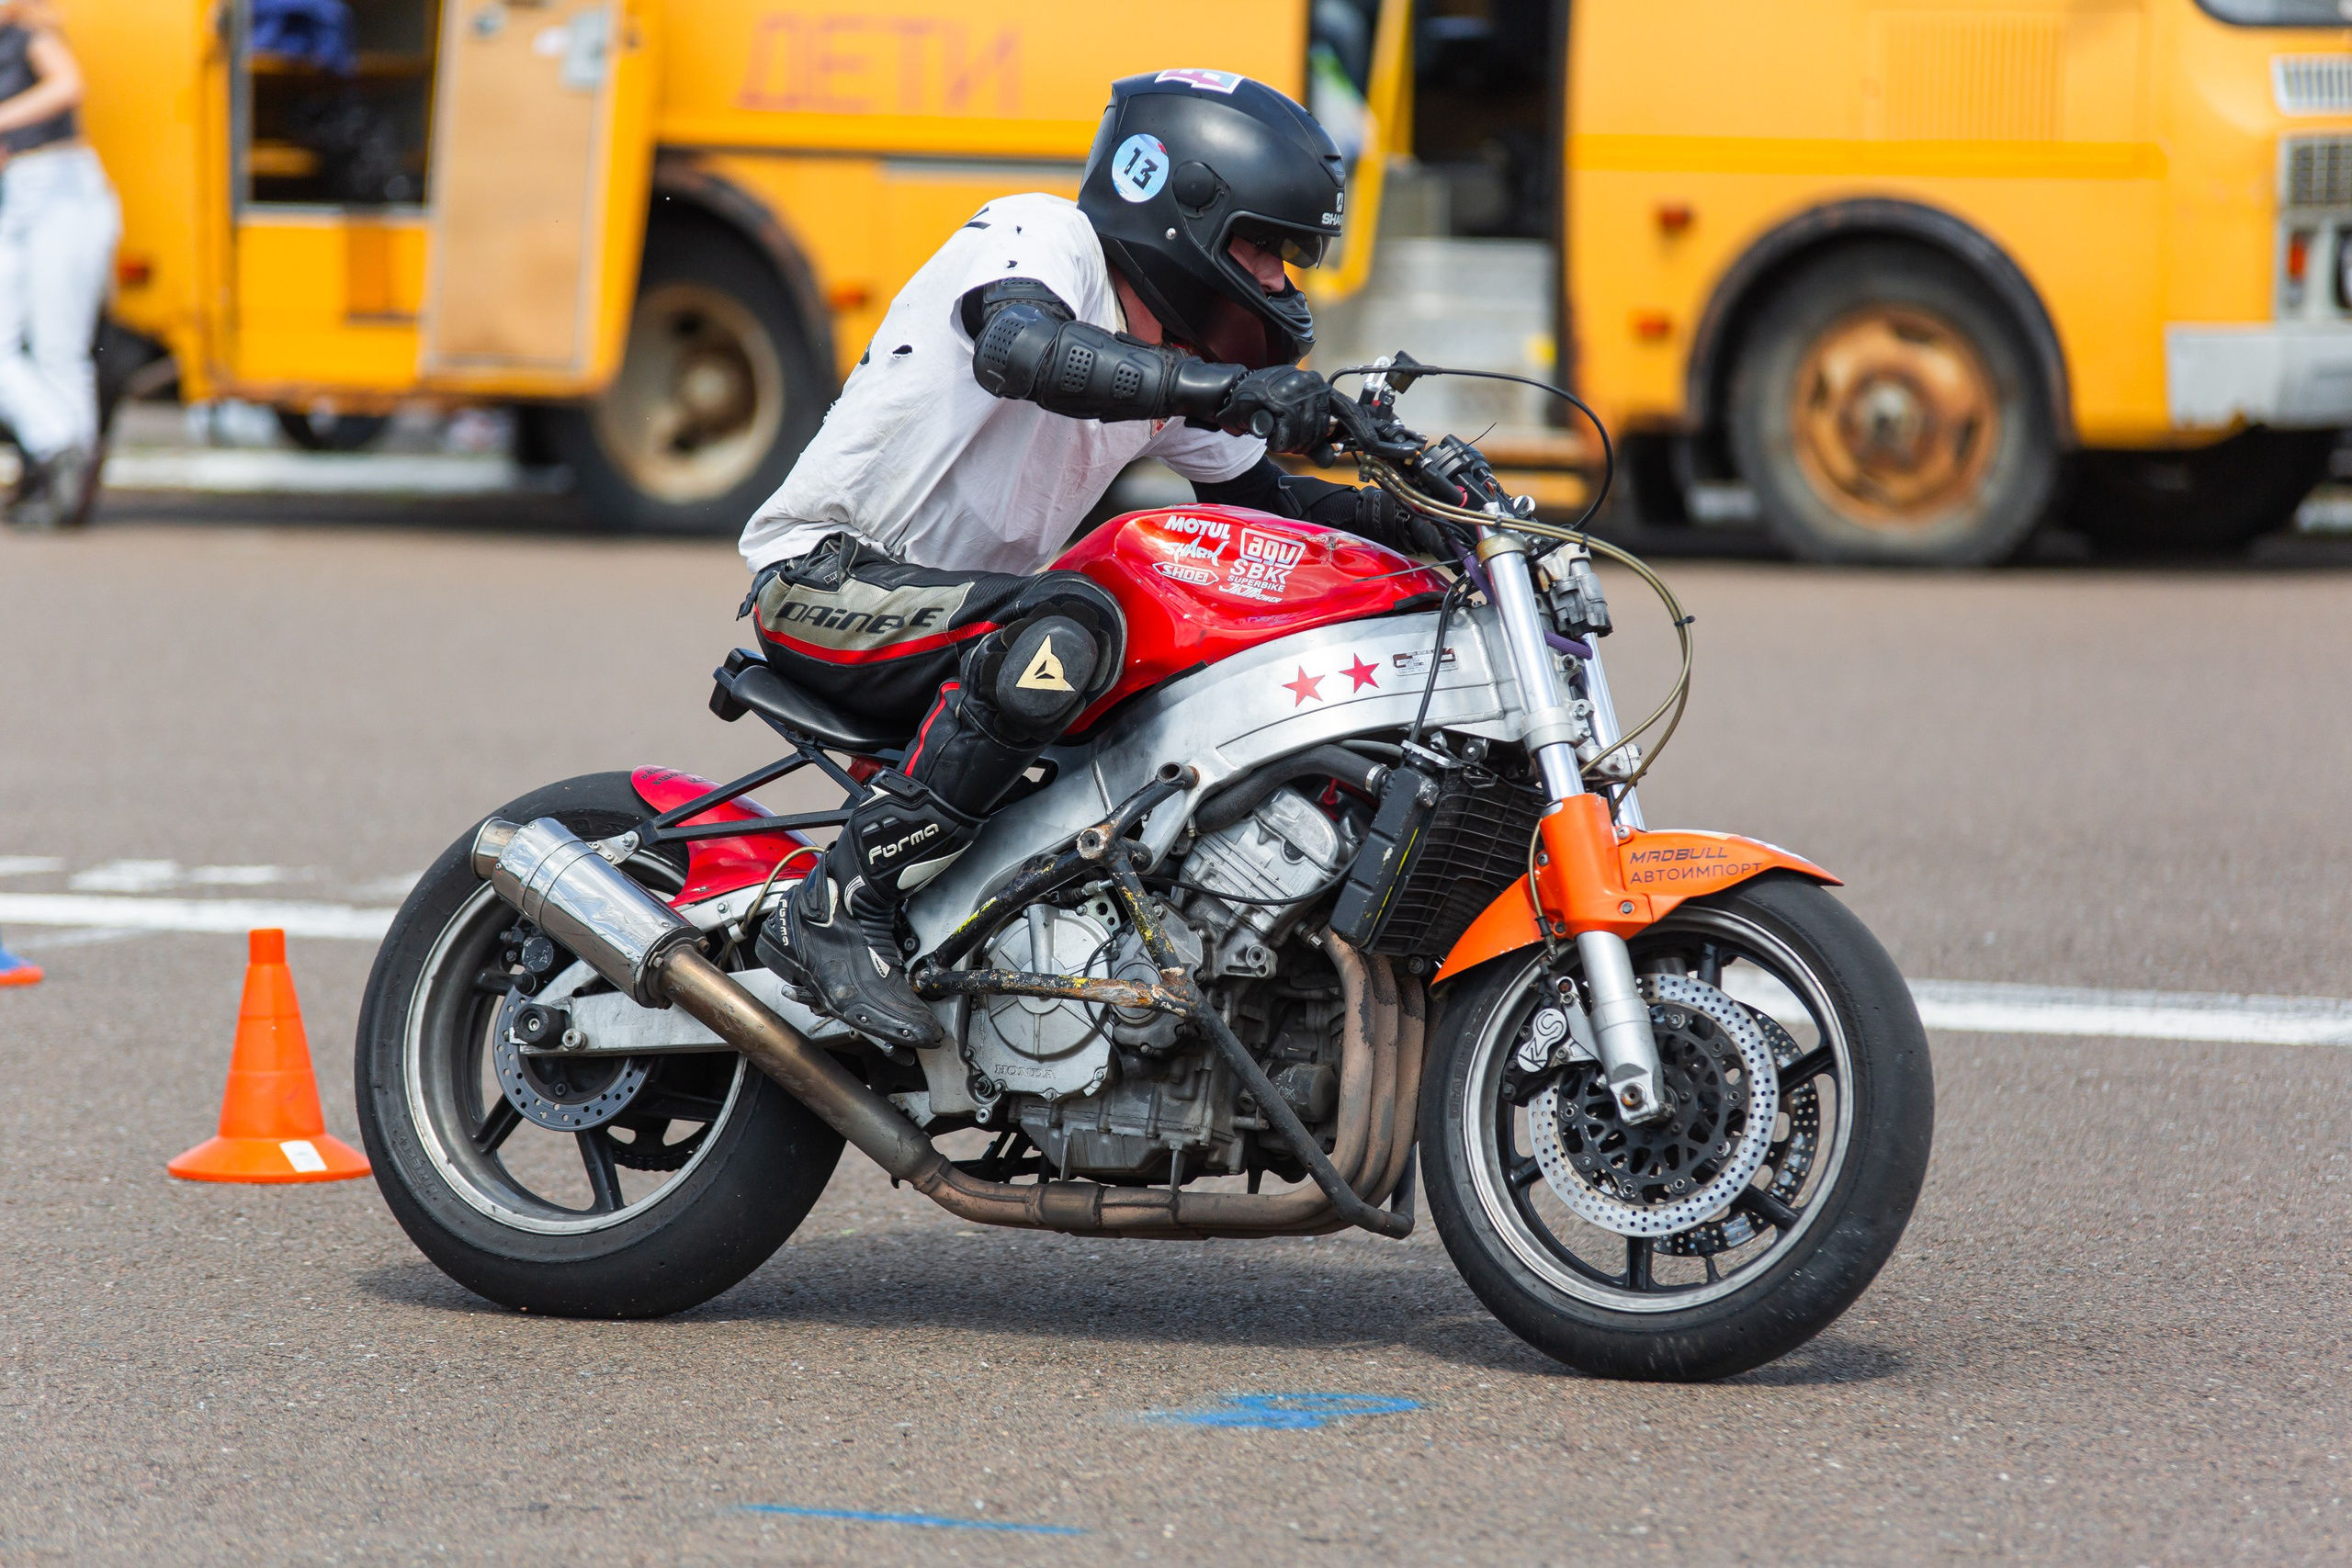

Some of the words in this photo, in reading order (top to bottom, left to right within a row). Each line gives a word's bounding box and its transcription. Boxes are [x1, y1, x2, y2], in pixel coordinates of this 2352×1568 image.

[729, 10, 1024, 118] ДЕТИ
[1124, 147, 1159, 189] 13
[1164, 514, 1231, 540] MOTUL
[1163, 536, 1230, 567] SHARK
[1161, 564, 1210, 583] SHOEI
[1227, 574, 1286, 592] SUPERBIKE
[1229, 558, 1291, 585] SBK
[1629, 846, 1728, 865] MADBULL
[1629, 862, 1763, 885] АВТОИМПОРТ
[994, 1064, 1057, 1079] HONDA
